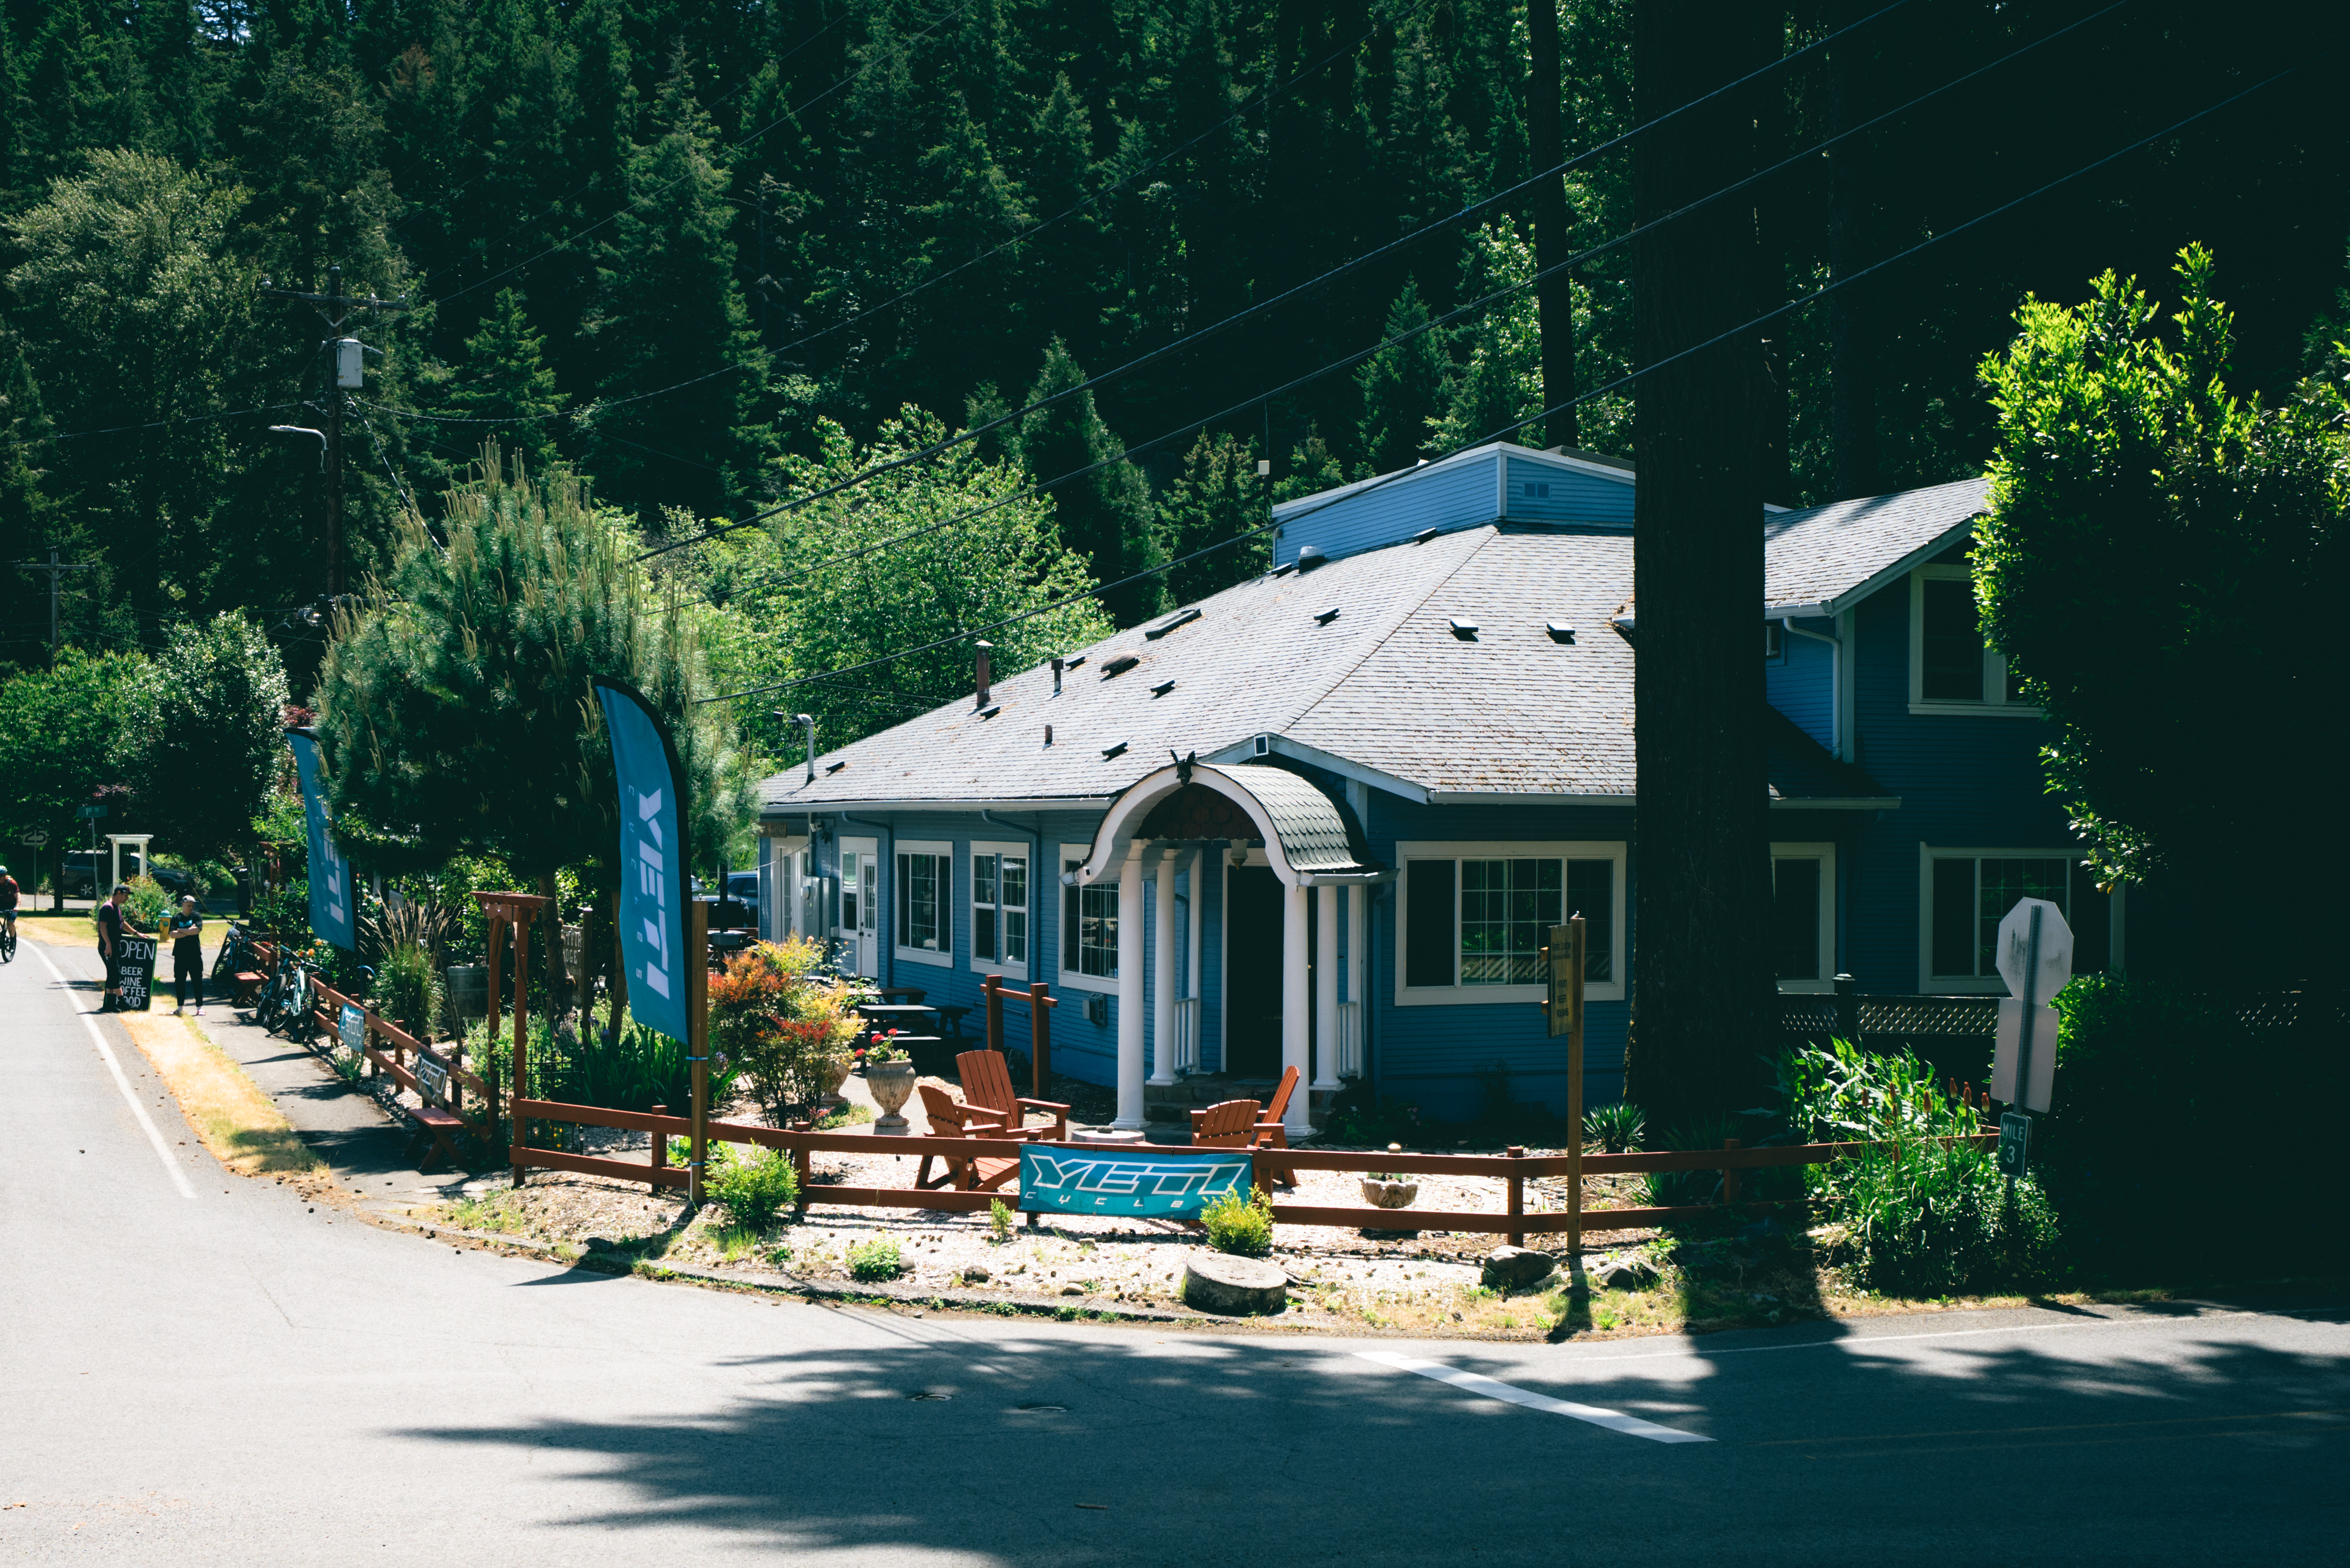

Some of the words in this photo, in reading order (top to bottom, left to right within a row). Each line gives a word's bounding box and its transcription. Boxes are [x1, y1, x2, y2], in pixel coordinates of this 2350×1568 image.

[24, 827, 47, 843] 25
[639, 787, 670, 1000] YETI
[119, 939, 155, 961] OPEN
[120, 966, 144, 976] BEER
[119, 976, 143, 987] WINE
[1557, 979, 1567, 988] FOOD
[120, 986, 147, 997] OFFEE
[1557, 994, 1567, 1004] BEER
[1556, 1007, 1569, 1017] ROOMS
[2002, 1122, 2024, 1142] MILE
[2006, 1145, 2015, 1164] 3
[1028, 1154, 1248, 1196] YETI
